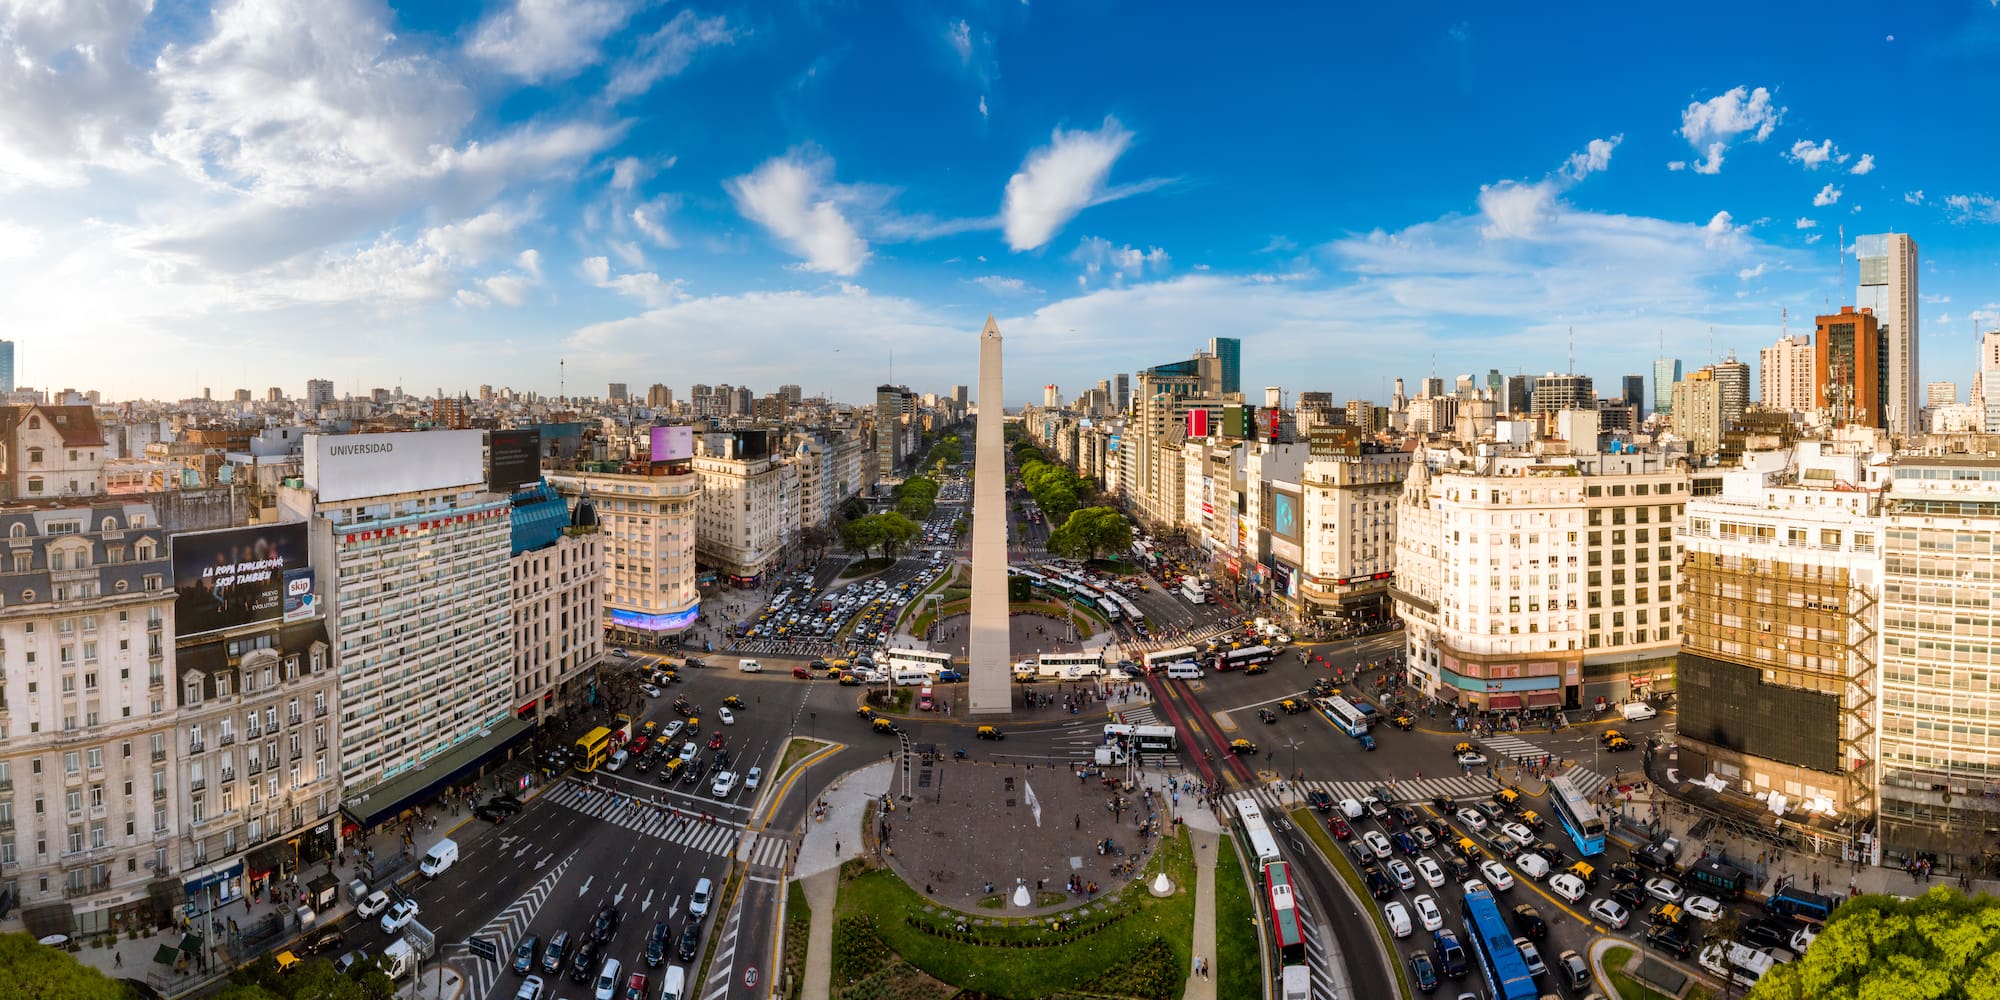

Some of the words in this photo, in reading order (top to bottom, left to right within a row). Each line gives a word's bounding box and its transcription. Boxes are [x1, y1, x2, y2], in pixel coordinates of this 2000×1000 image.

[330, 443, 392, 455] UNIVERSIDAD
[346, 526, 408, 543] HOTEL
[419, 507, 509, 530] REPUBLICA
[203, 568, 213, 577] LA
[216, 564, 235, 575] ROPA
[216, 576, 234, 587] SKIP
[291, 581, 307, 591] skip
[746, 970, 757, 983] 20
